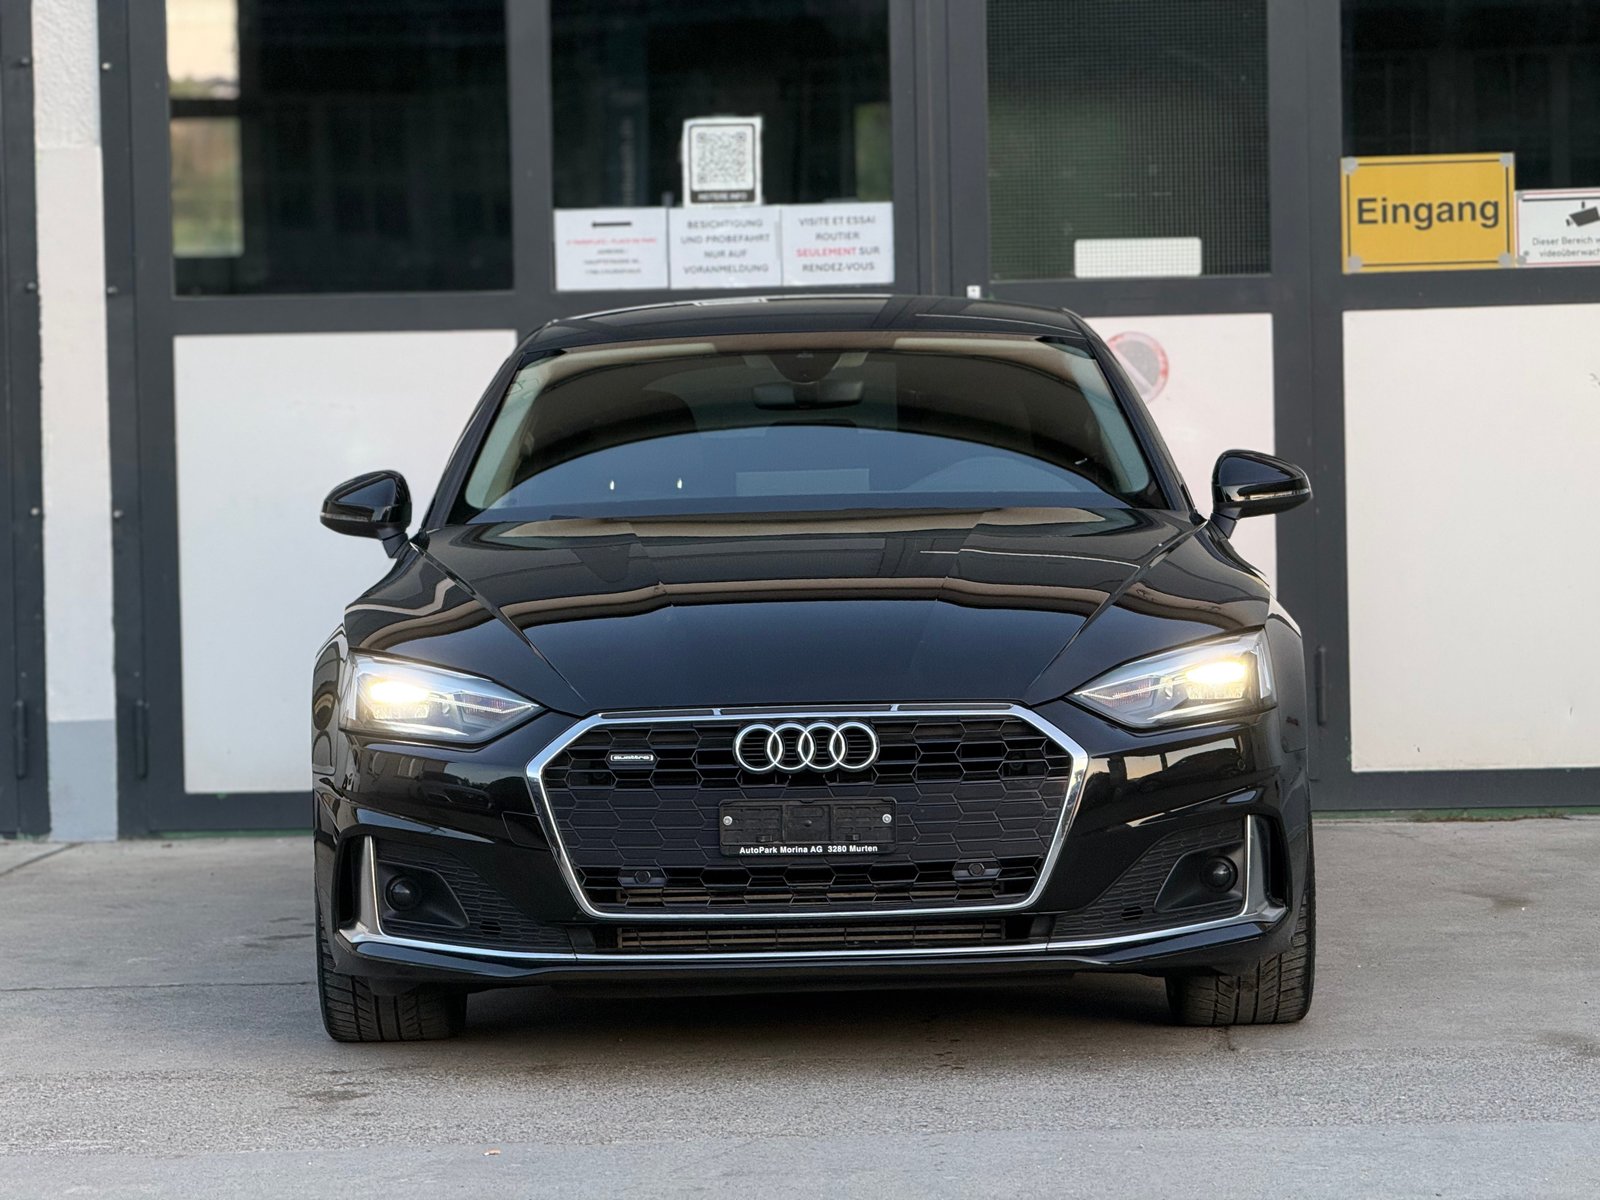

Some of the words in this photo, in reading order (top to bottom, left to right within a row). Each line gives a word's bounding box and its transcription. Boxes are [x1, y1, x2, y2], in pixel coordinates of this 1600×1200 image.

[1357, 196, 1500, 231] Eingang
[687, 219, 763, 229] BESICHTIGUNG
[798, 216, 830, 226] VISITE
[832, 216, 844, 225] ET
[846, 215, 876, 225] ESSAI
[680, 235, 703, 244] UND
[705, 233, 770, 243] PROBEFAHRT
[815, 232, 860, 241] ROUTIER
[1532, 237, 1559, 246] Dieser
[1561, 236, 1593, 245] Bereich
[704, 250, 726, 259] NUR
[728, 249, 747, 258] AUF
[796, 246, 857, 257] SEULEMENT
[858, 246, 880, 255] SUR
[683, 263, 769, 274] VORANMELDUNG
[802, 262, 875, 272] RENDEZ-VOUS
[739, 846, 778, 854] AutoPark
[779, 845, 808, 854] Morina
[810, 845, 823, 853] AG
[827, 845, 847, 853] 3280
[849, 845, 878, 853] Murten
